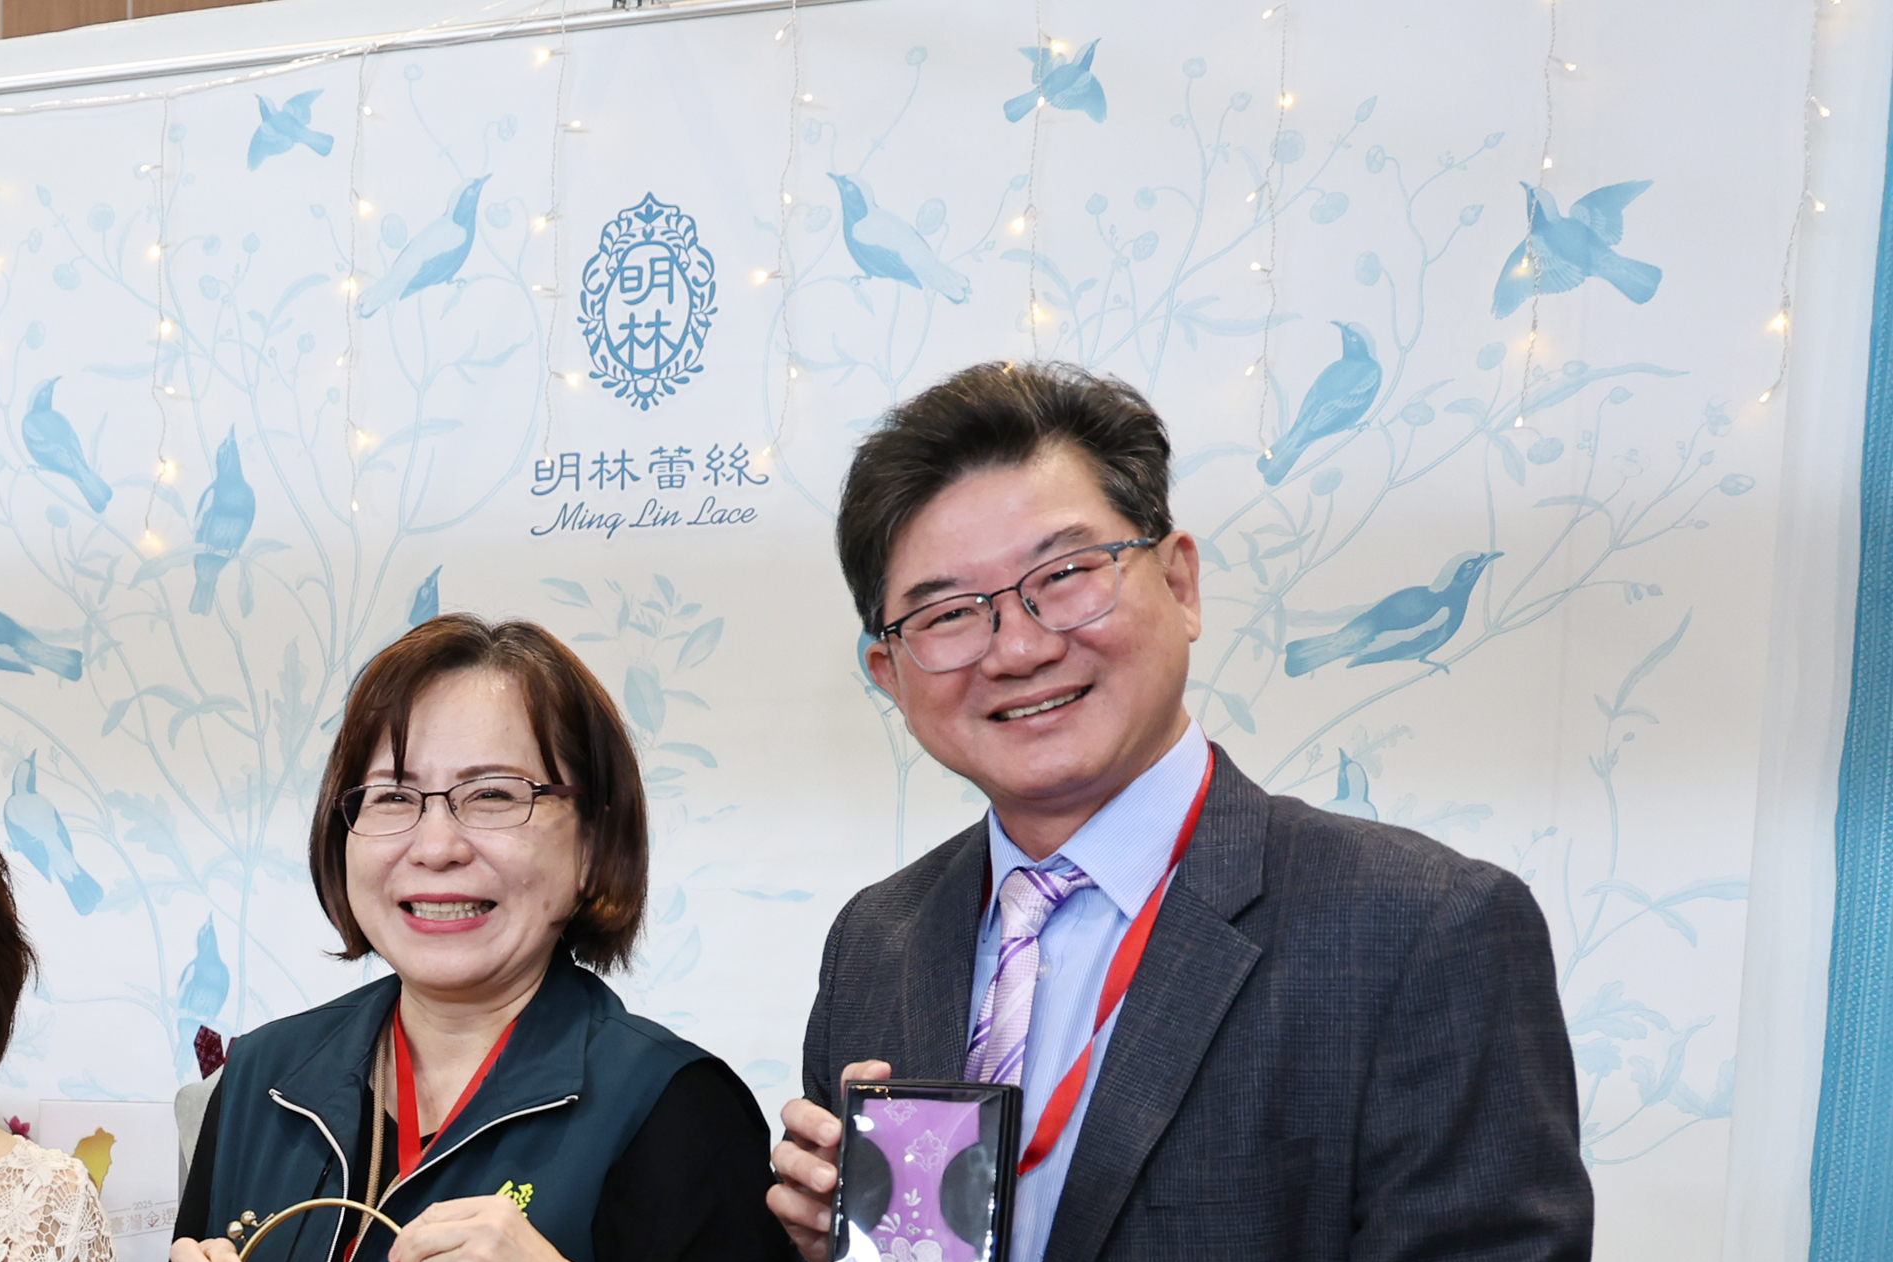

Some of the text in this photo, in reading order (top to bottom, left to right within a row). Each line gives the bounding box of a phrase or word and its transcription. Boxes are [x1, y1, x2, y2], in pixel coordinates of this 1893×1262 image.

[531, 441, 770, 497] 明林蕾絲
[530, 495, 758, 540] Ming Lin Lace
